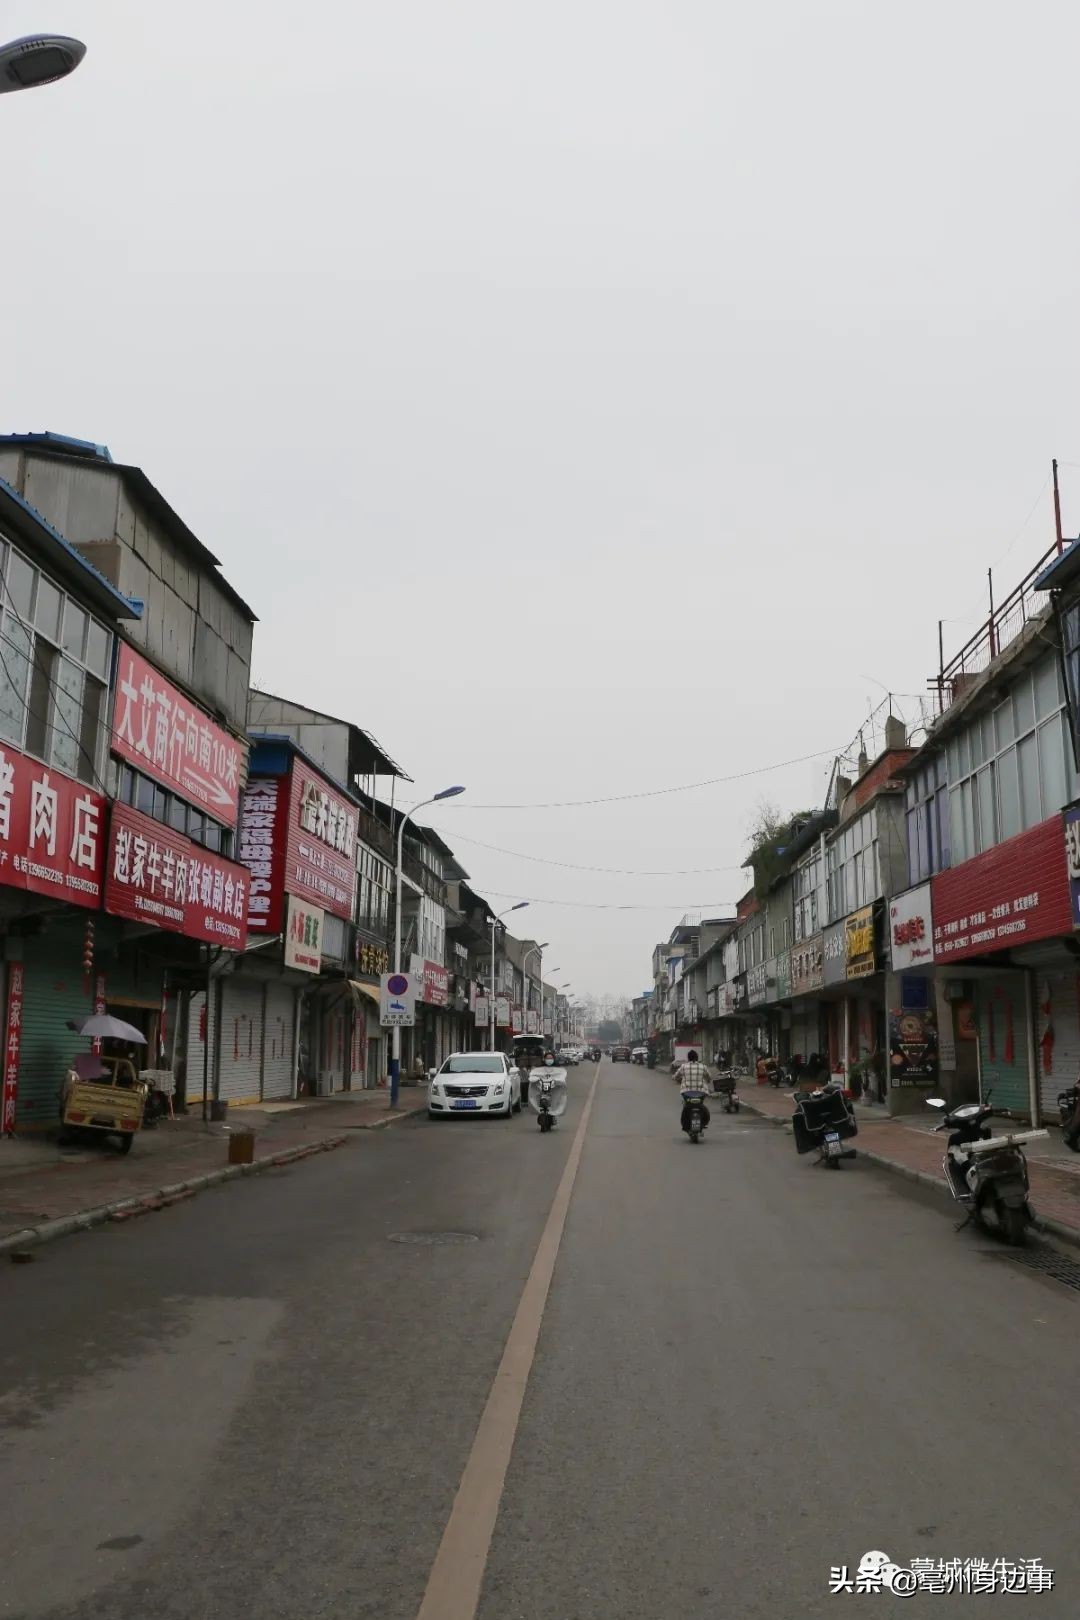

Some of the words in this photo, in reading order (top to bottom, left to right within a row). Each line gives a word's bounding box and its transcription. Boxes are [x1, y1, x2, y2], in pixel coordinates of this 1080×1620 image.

[5, 967, 23, 1124] 赵家牛羊肉
